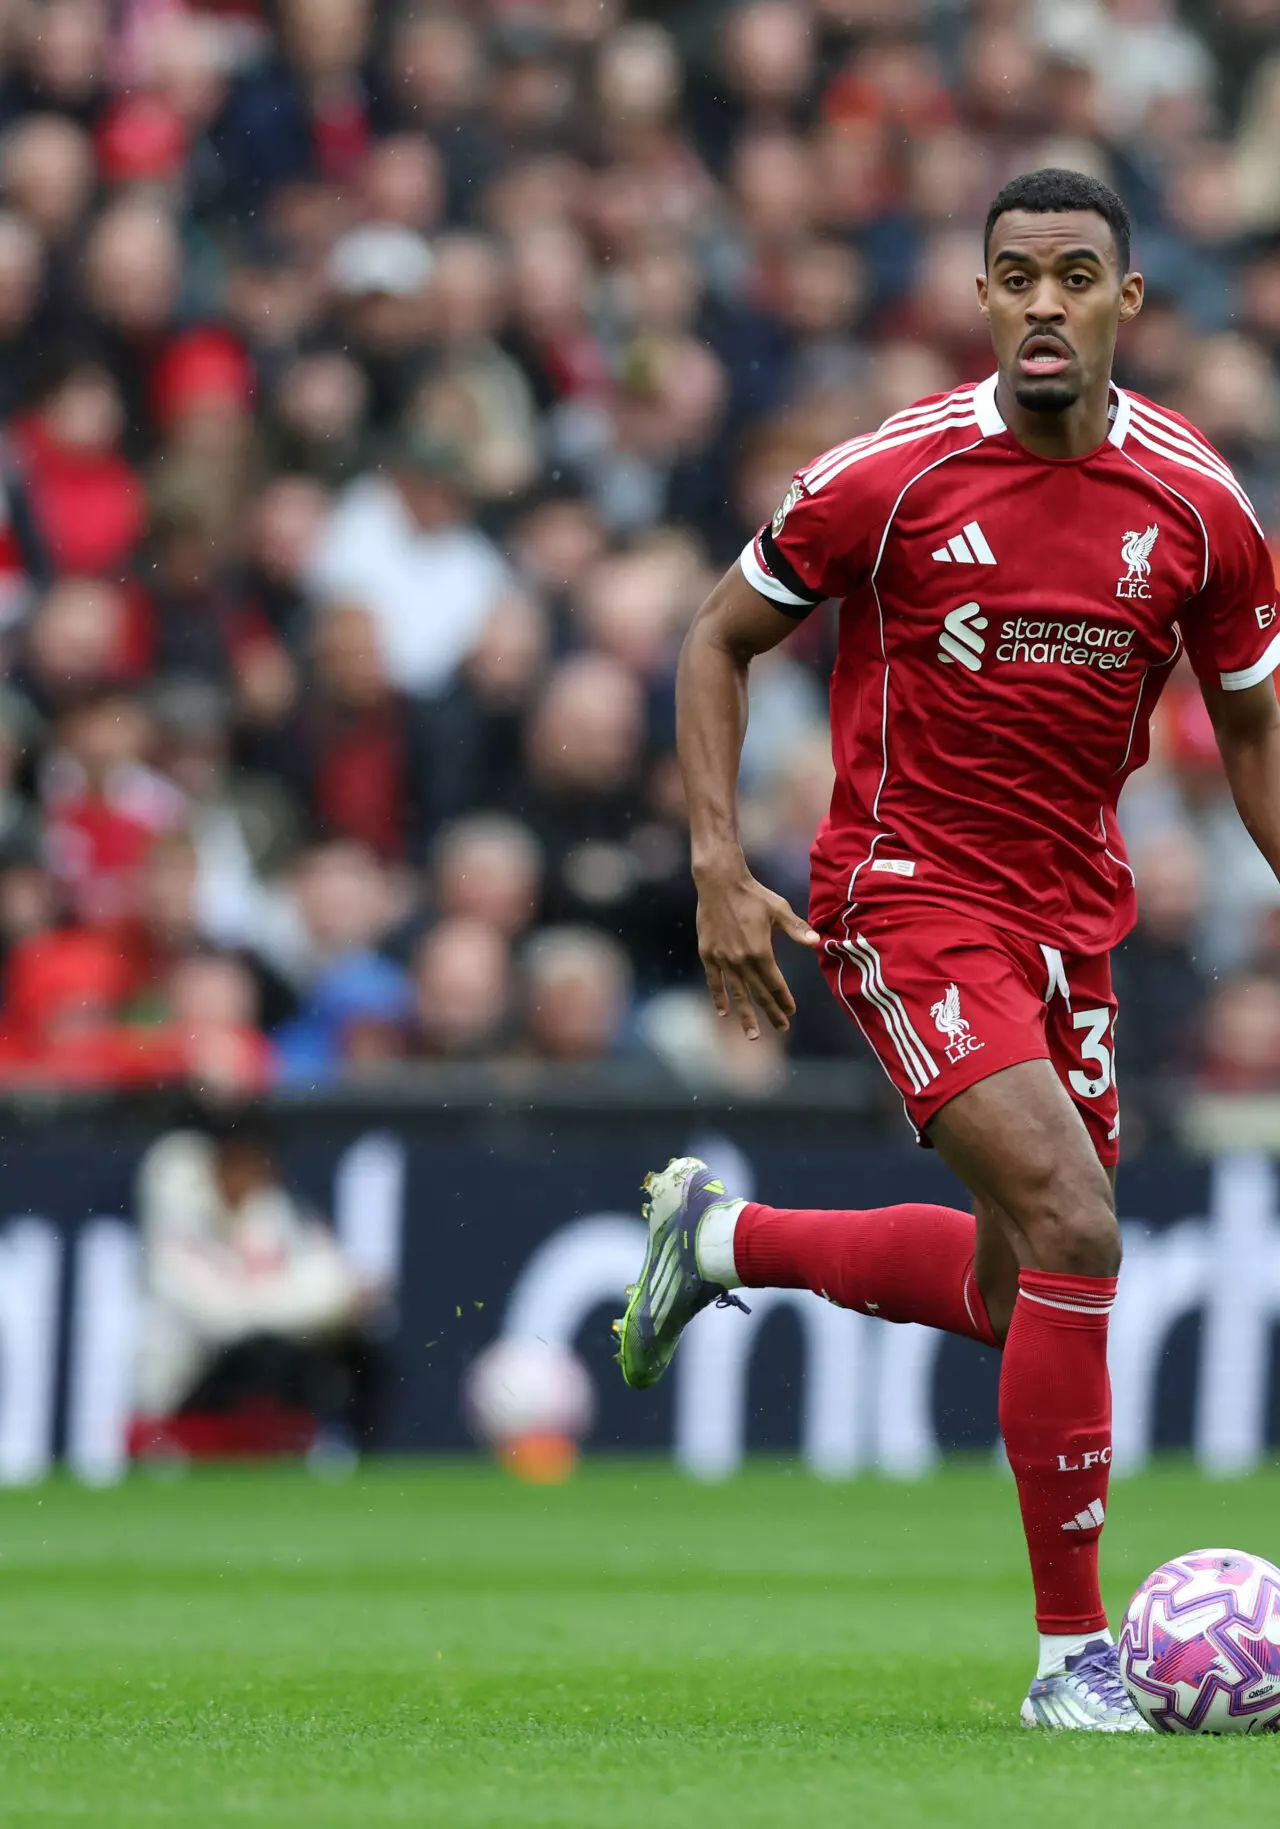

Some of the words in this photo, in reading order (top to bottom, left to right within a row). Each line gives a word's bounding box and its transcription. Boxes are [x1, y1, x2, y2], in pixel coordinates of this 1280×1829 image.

[1116, 582, 1152, 599] L.F.C.
[1000, 617, 1136, 648] standard
[996, 640, 1134, 670] chartered
[1057, 1447, 1111, 1471] LFC
